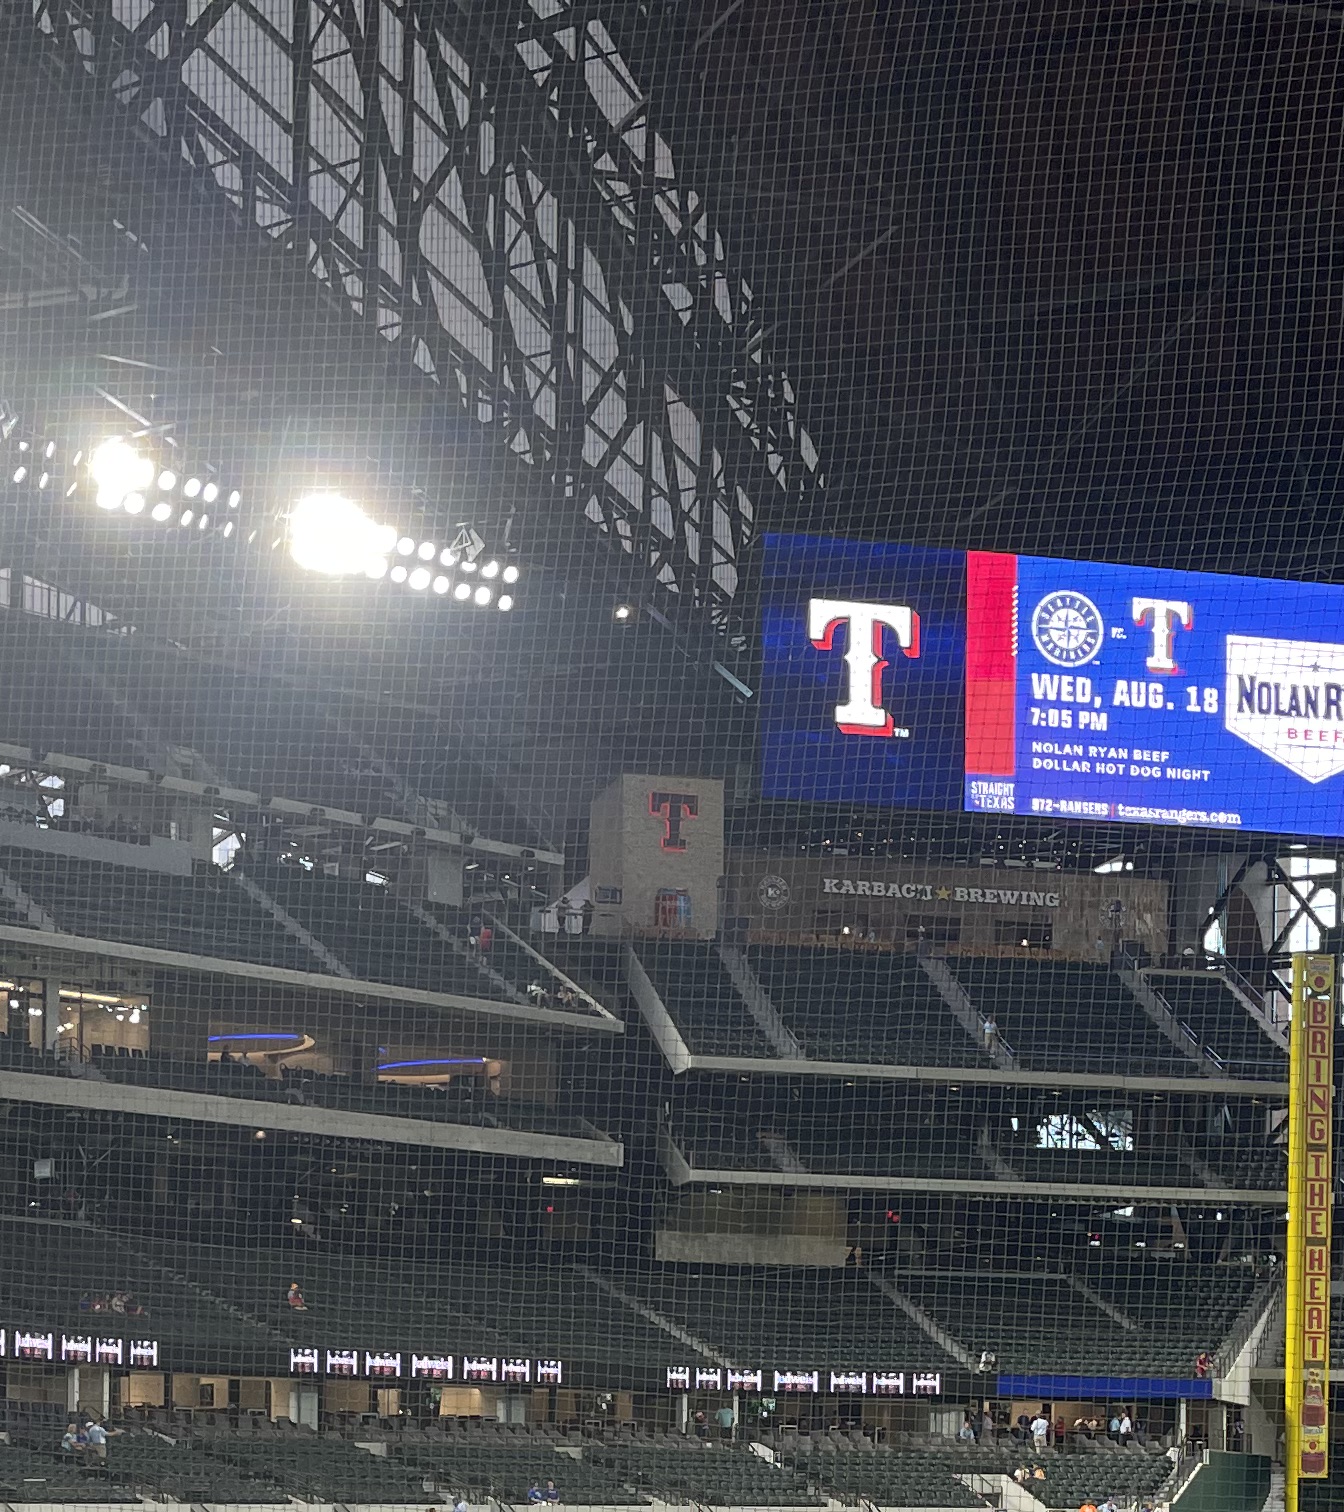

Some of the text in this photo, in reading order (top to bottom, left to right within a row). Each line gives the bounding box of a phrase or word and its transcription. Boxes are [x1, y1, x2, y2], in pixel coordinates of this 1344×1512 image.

[1132, 597, 1193, 674] T
[809, 598, 920, 736] T
[1031, 673, 1218, 713] WED, AUG. 18
[1031, 708, 1107, 731] 7:05 PM
[1288, 728, 1343, 742] BEEF
[1033, 742, 1169, 763] NOLAN RYAN BEEF
[1033, 758, 1210, 781] DOLLAR HOT DOG NIGHT
[971, 781, 1015, 797] STRAIGHT
[981, 795, 1015, 810] TEXAS
[1032, 798, 1108, 815] 972-RANGERS
[648, 792, 698, 852] T
[1118, 805, 1242, 825] texasrangers.com
[955, 887, 1060, 907] BREWING
[1308, 999, 1327, 1143] BRING
[1308, 1152, 1326, 1237] THE
[1307, 1245, 1325, 1361] HEAT
